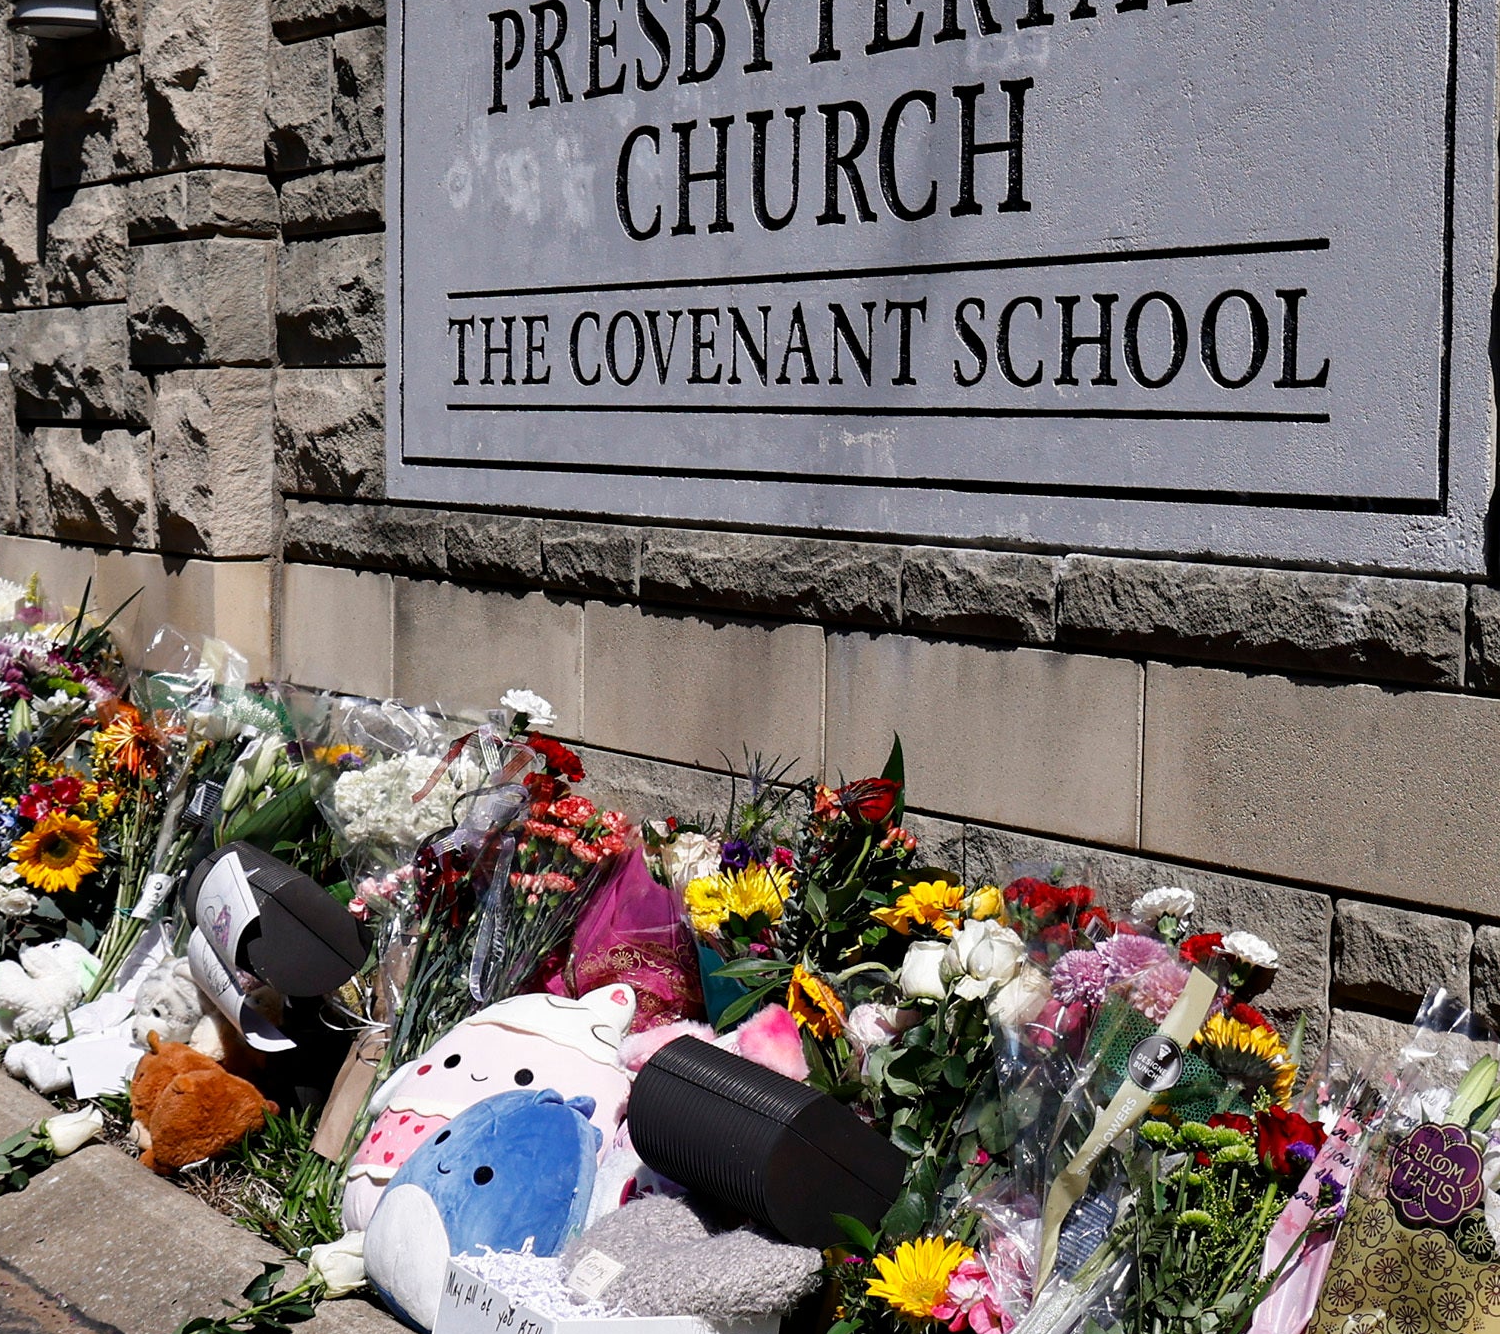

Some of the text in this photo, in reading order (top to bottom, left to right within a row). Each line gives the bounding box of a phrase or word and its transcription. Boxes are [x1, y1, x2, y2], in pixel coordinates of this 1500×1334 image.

[615, 77, 1035, 241] CHURCH
[448, 286, 1331, 391] THE COVENANT SCHOOL
[1403, 1163, 1455, 1205] HAUS
[1414, 1143, 1466, 1184] BLOOM
